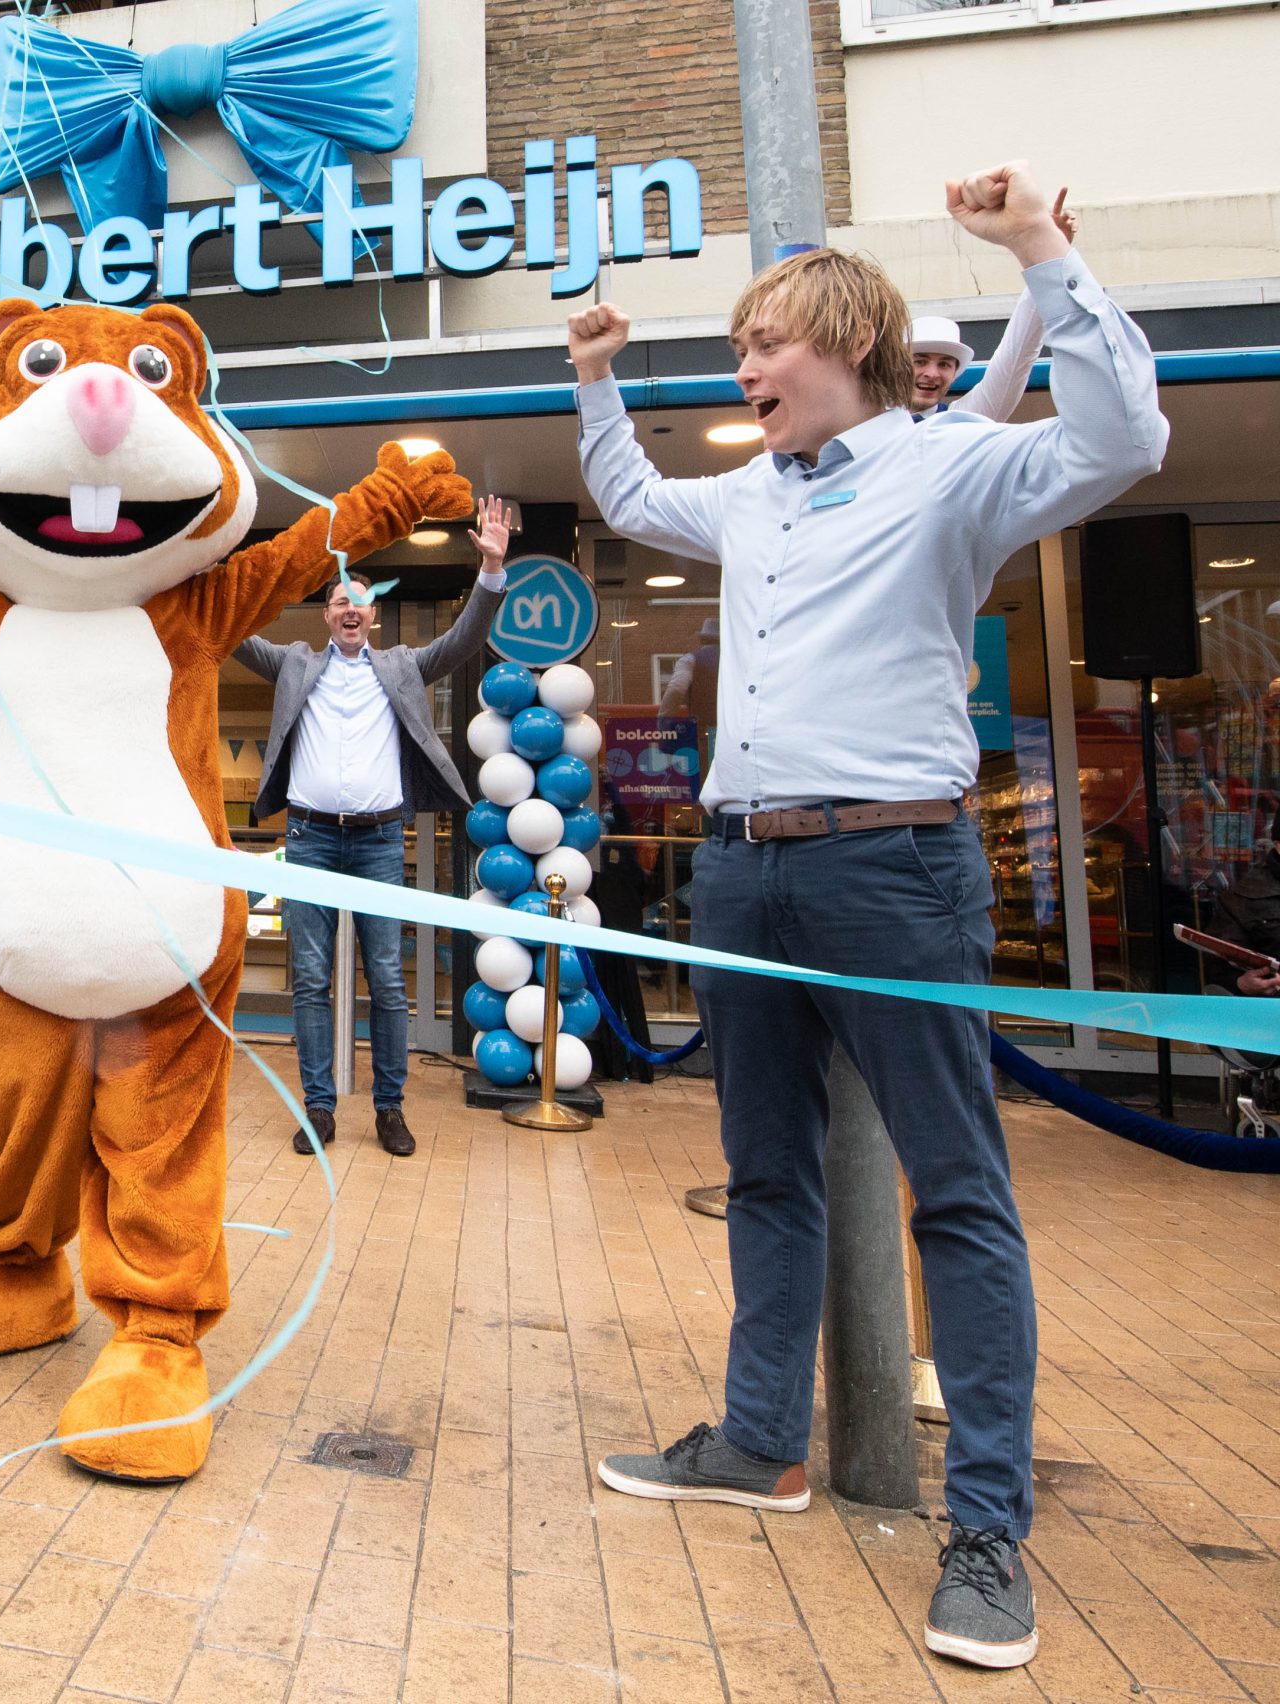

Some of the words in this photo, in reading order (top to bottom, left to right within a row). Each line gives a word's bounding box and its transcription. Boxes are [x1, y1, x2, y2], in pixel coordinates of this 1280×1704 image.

[322, 135, 701, 298] Heijn
[616, 728, 678, 741] bol.com
[619, 784, 671, 794] afhaalpunt
